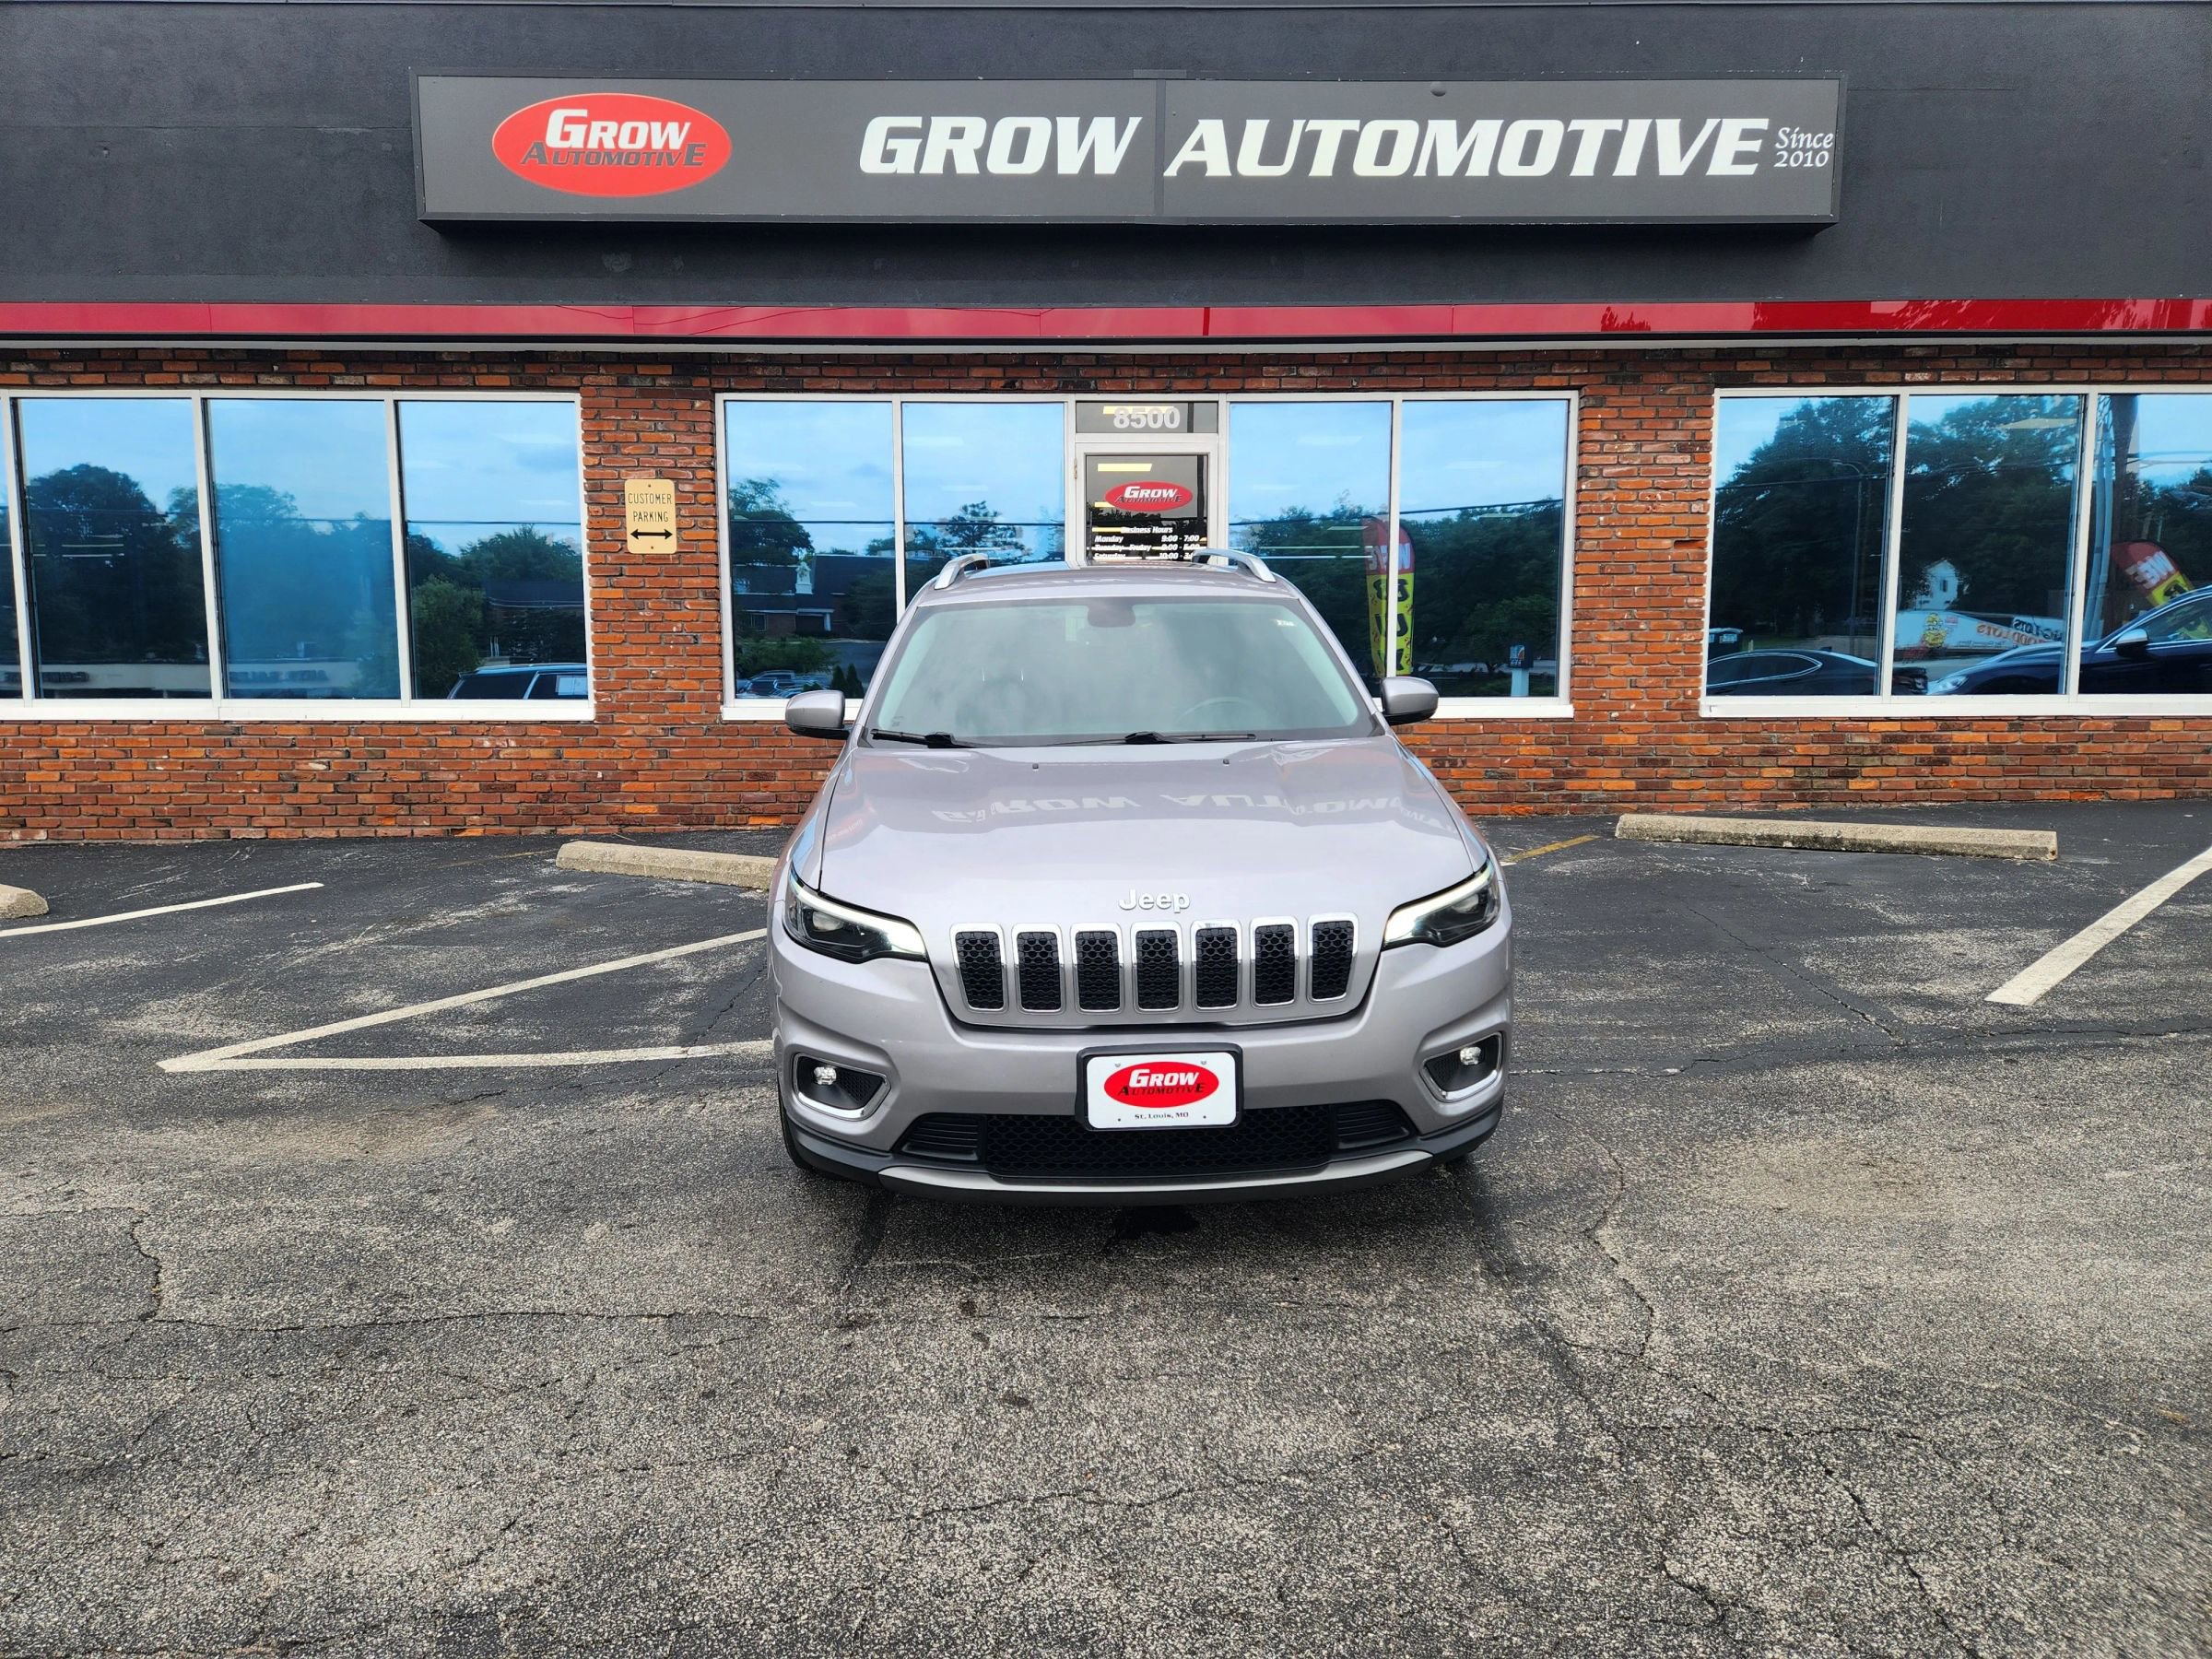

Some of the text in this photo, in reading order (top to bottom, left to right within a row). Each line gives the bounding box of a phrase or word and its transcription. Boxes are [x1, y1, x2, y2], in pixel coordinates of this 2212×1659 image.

[546, 109, 691, 150] GROW
[1775, 126, 1834, 148] Since
[521, 140, 707, 166] AUTOMOTIVE
[859, 116, 1770, 177] GROW AUTOMOTIVE
[1773, 150, 1830, 167] 2010
[1112, 406, 1180, 429] 8500
[628, 492, 672, 504] CUSTOMER
[1124, 486, 1179, 499] GROW
[632, 511, 669, 523] PARKING
[1118, 888, 1190, 913] Jeep
[1129, 1069, 1199, 1088] GROW
[1117, 1083, 1206, 1097] AUTOMOTIVE
